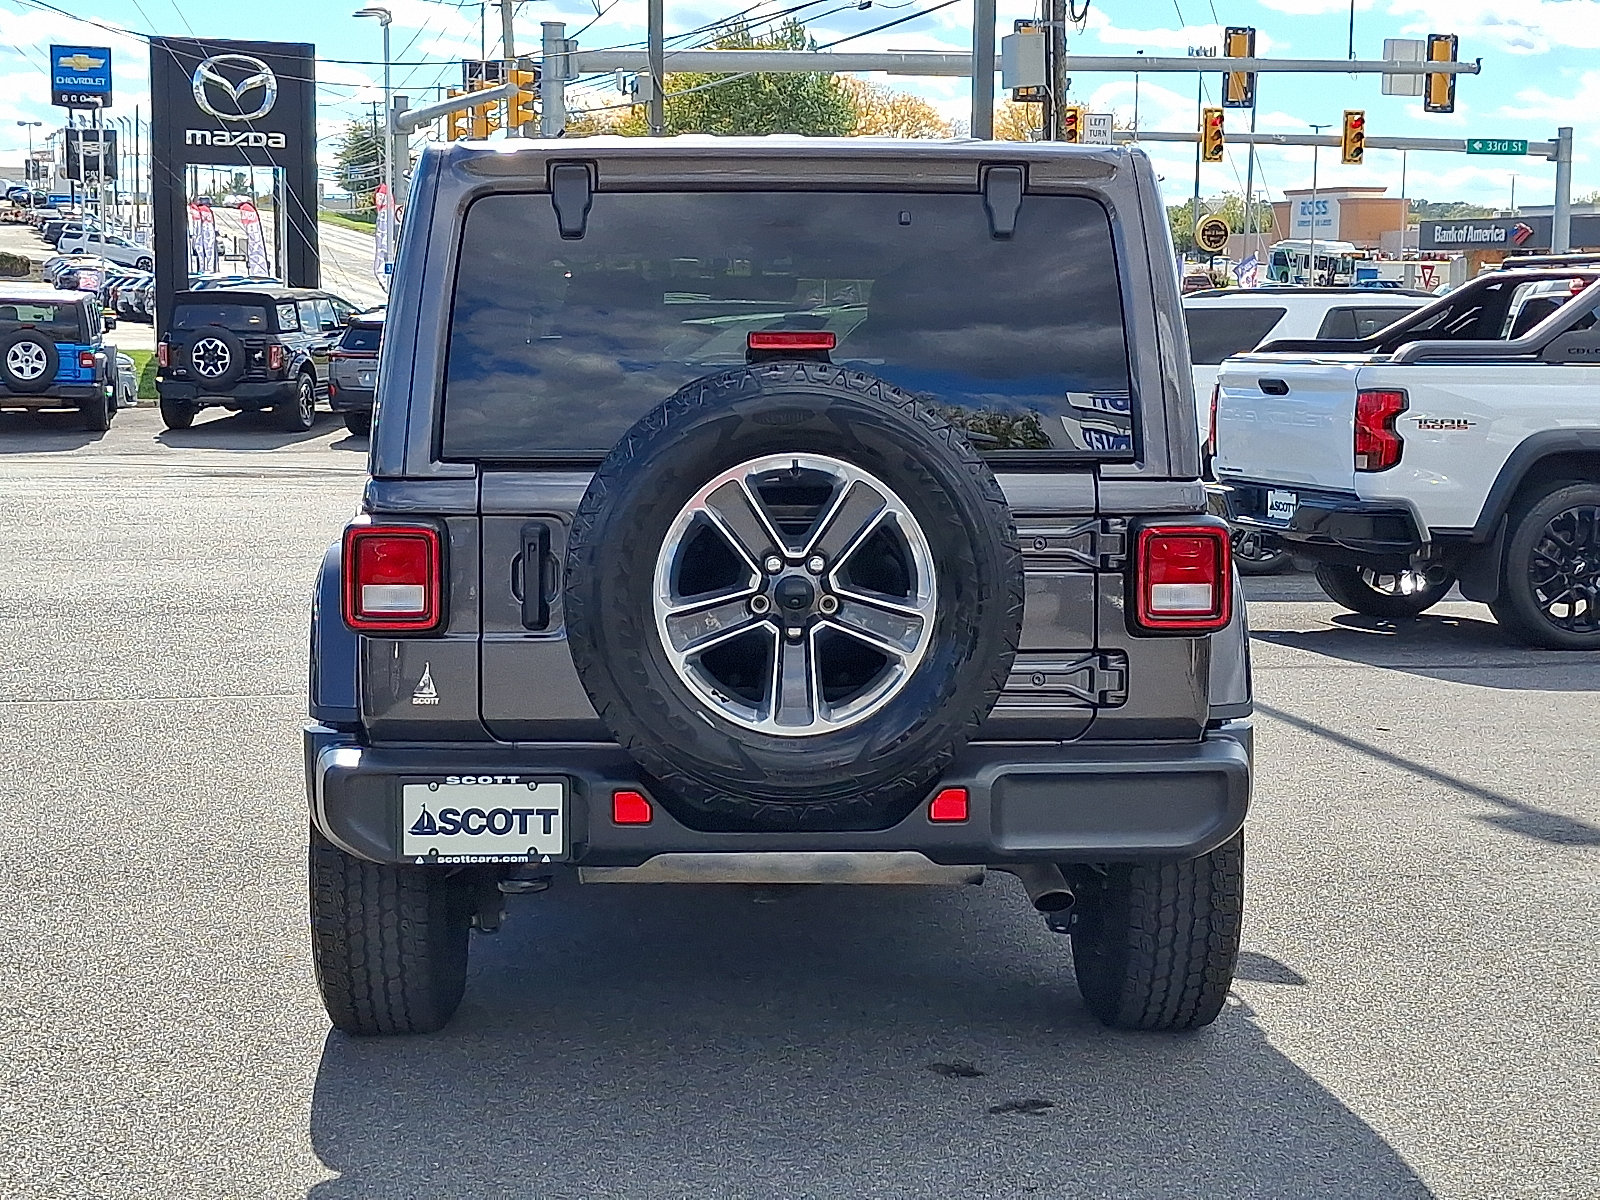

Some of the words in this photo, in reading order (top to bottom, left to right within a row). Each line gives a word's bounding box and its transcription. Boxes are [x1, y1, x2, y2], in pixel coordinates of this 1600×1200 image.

[56, 76, 106, 86] CHEVROLET
[1089, 118, 1106, 126] LEFT
[1089, 129, 1107, 138] TURN
[1486, 140, 1508, 151] 33rd
[1512, 141, 1522, 151] St
[412, 697, 440, 705] SCOTT
[446, 776, 520, 785] SCOTT
[438, 807, 559, 836] SCOTT
[437, 855, 529, 864] scottcars.com
